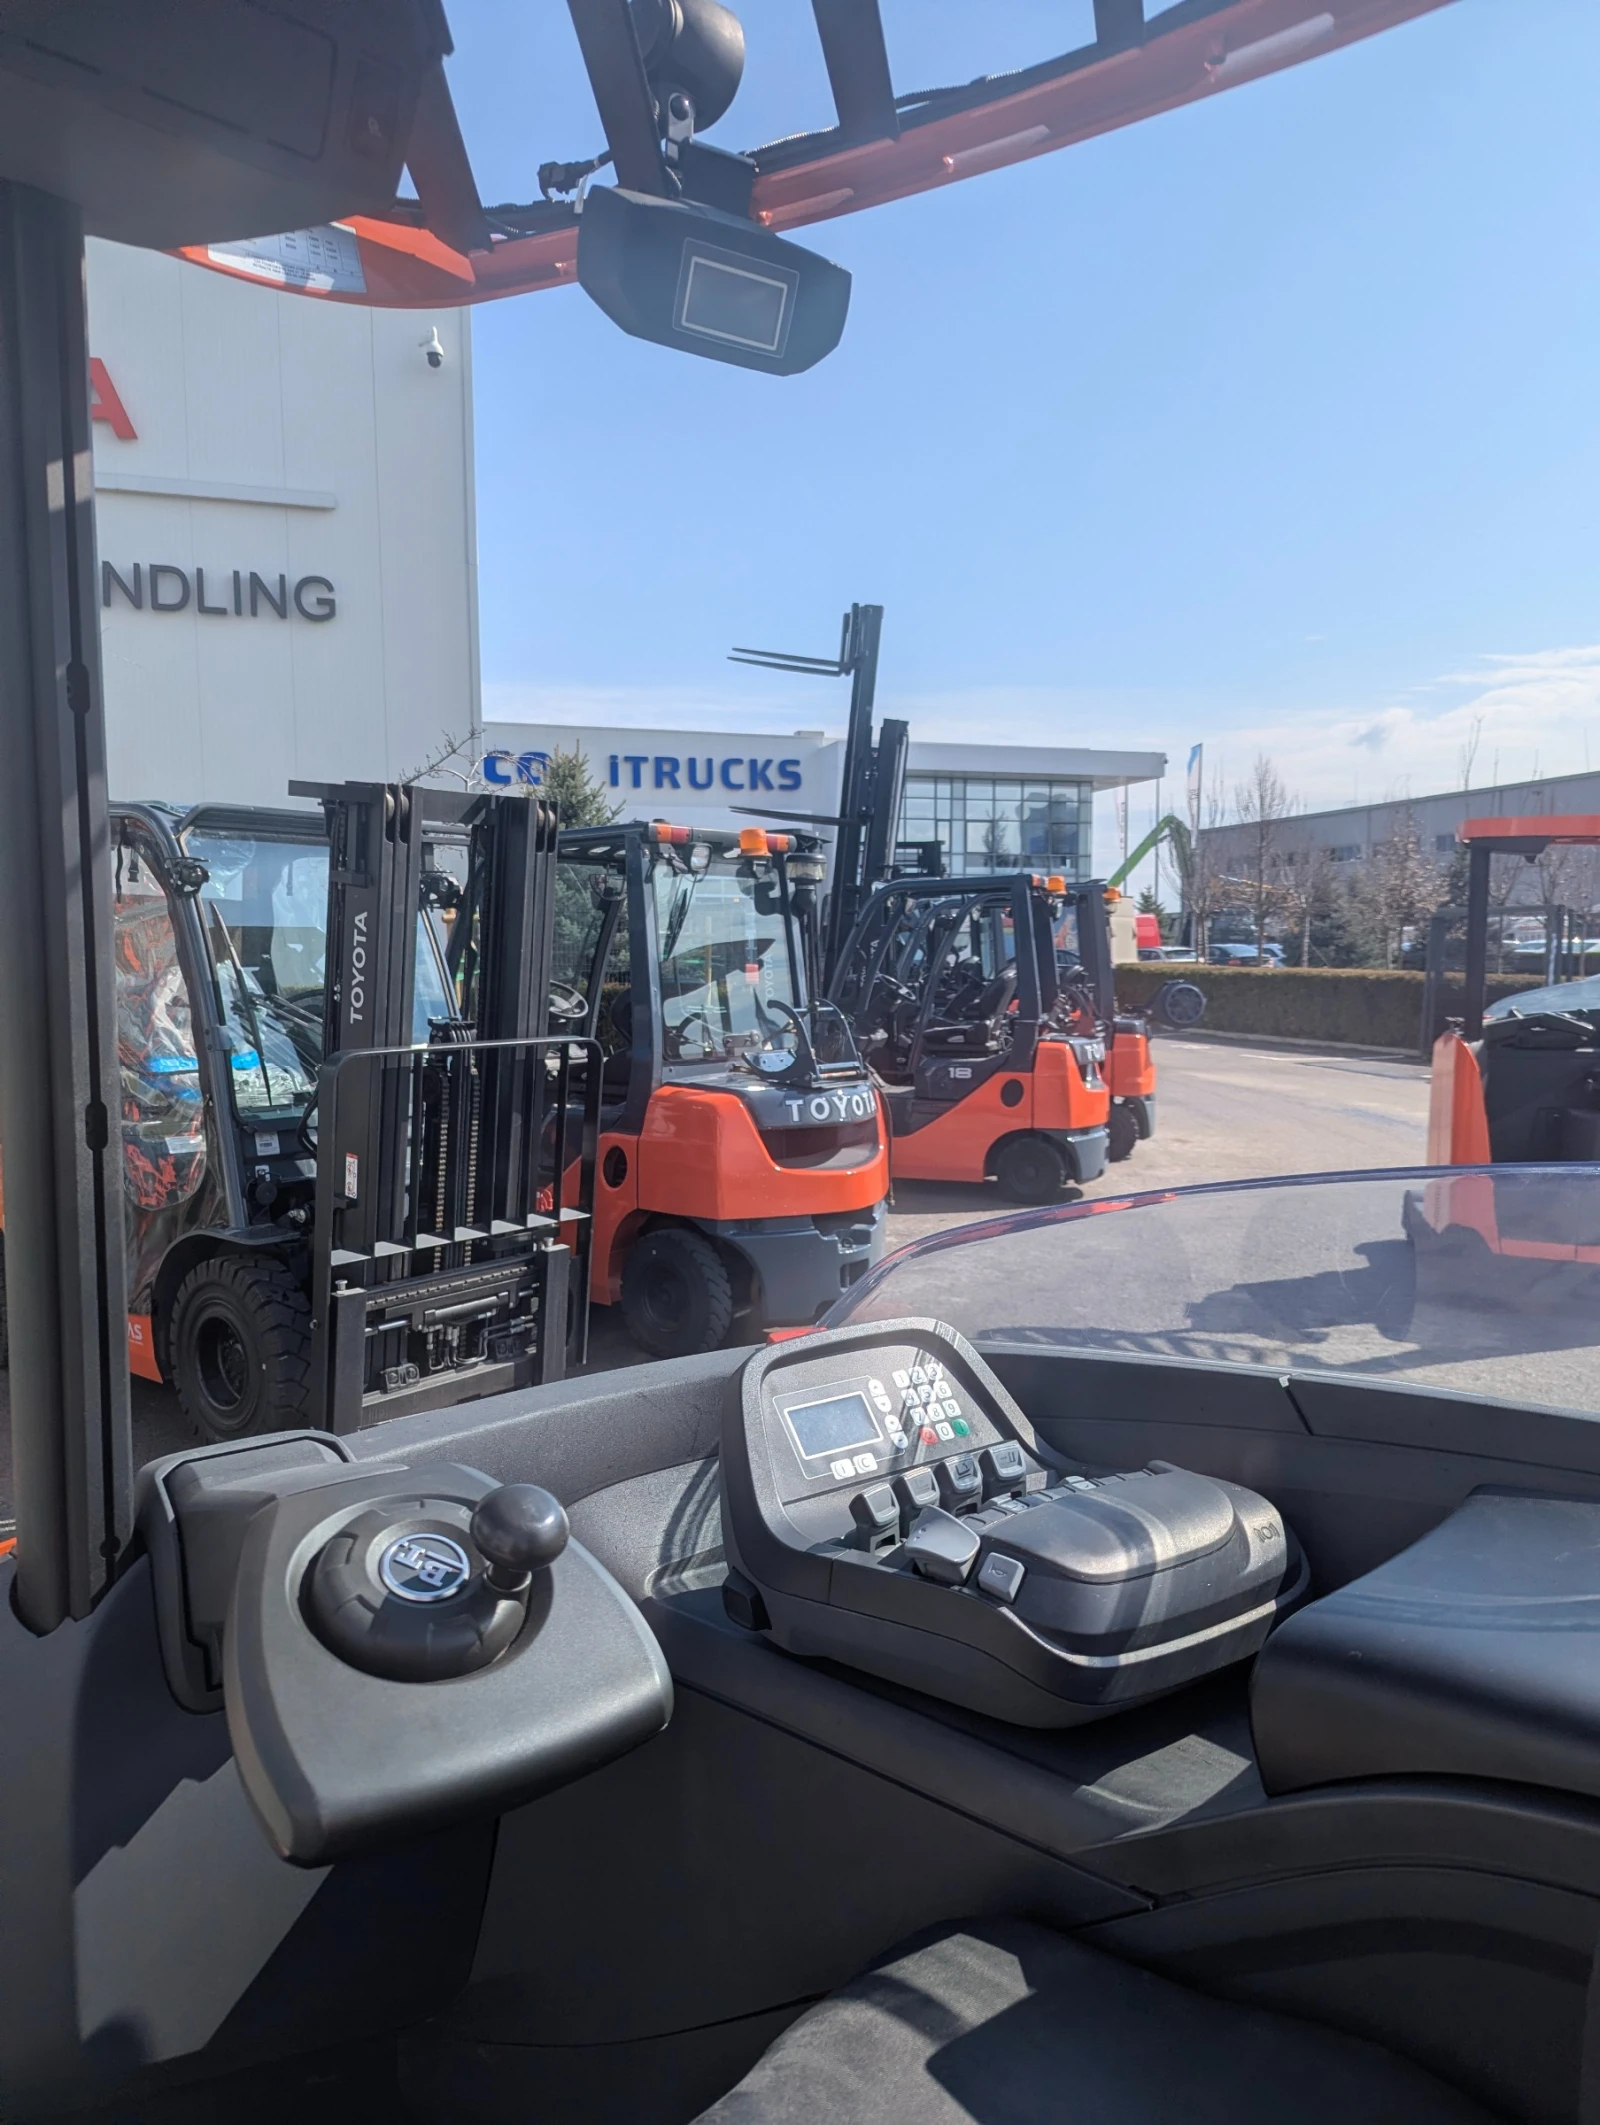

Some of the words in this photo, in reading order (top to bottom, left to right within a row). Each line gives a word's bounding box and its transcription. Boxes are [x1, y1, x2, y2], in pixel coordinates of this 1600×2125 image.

[101, 560, 336, 622] NDLING
[350, 911, 368, 1024] TOYOTA
[948, 1067, 972, 1079] 18
